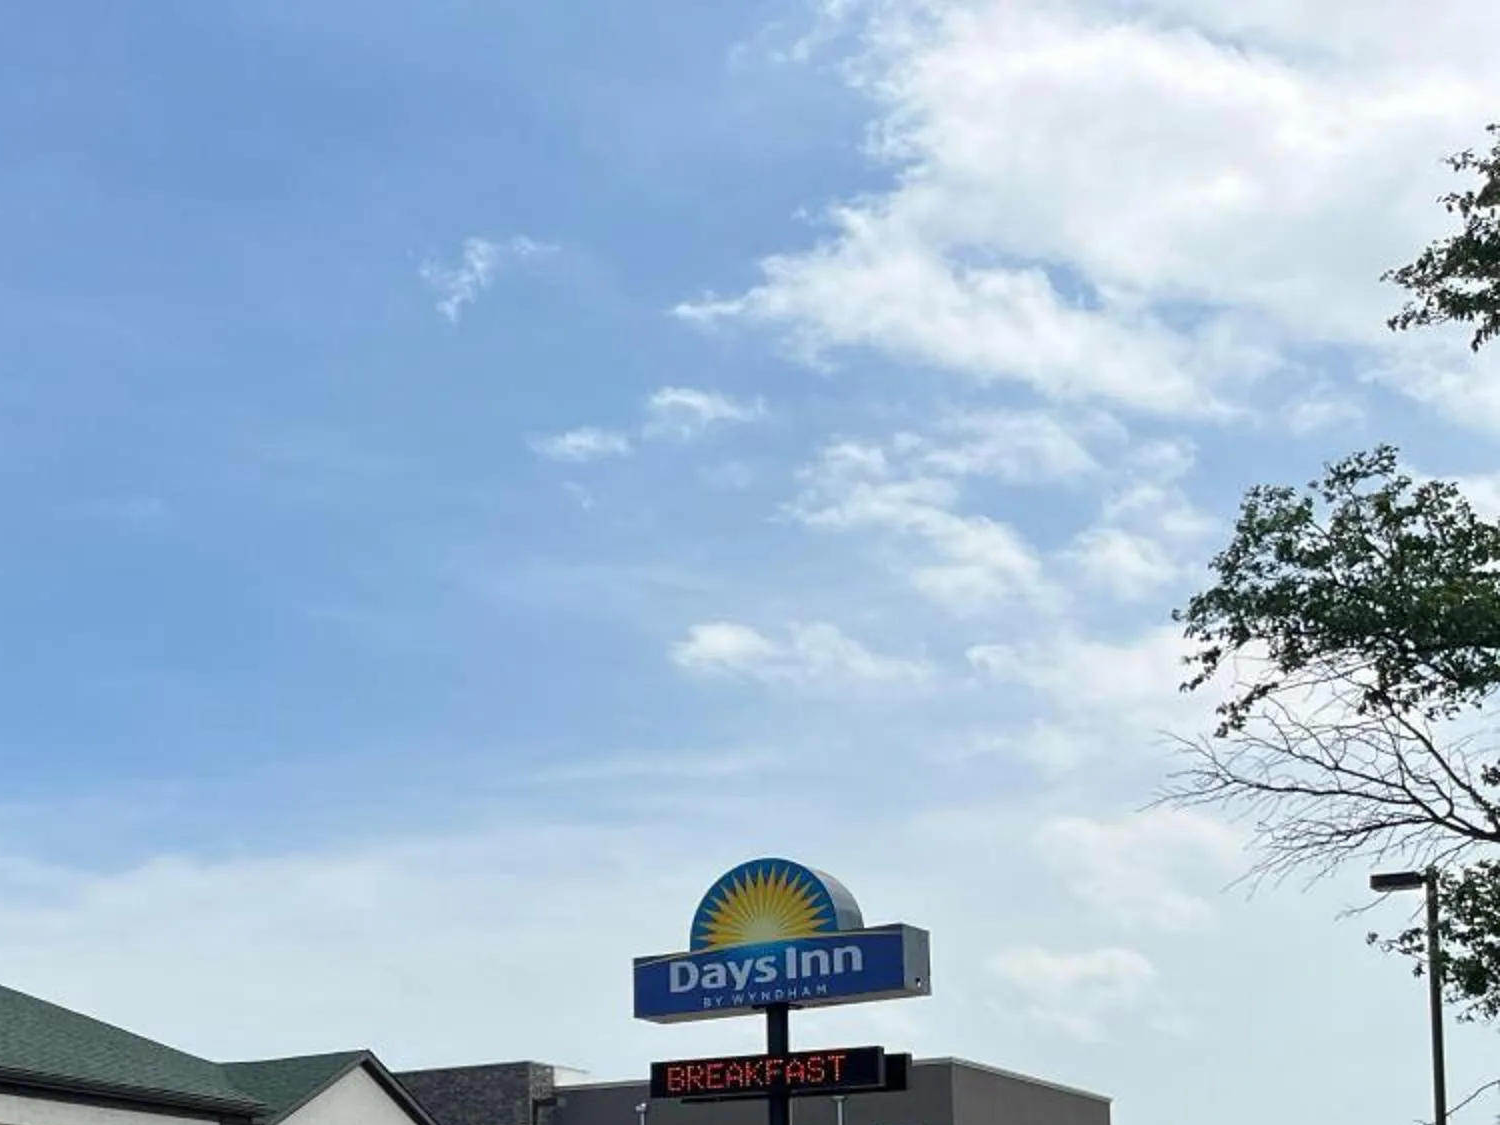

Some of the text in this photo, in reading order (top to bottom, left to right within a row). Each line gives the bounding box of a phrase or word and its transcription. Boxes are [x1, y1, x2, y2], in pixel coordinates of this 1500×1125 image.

[669, 945, 863, 993] Days Inn
[703, 984, 828, 1008] BY WYNDHAM
[667, 1055, 846, 1092] BREAKFAST
